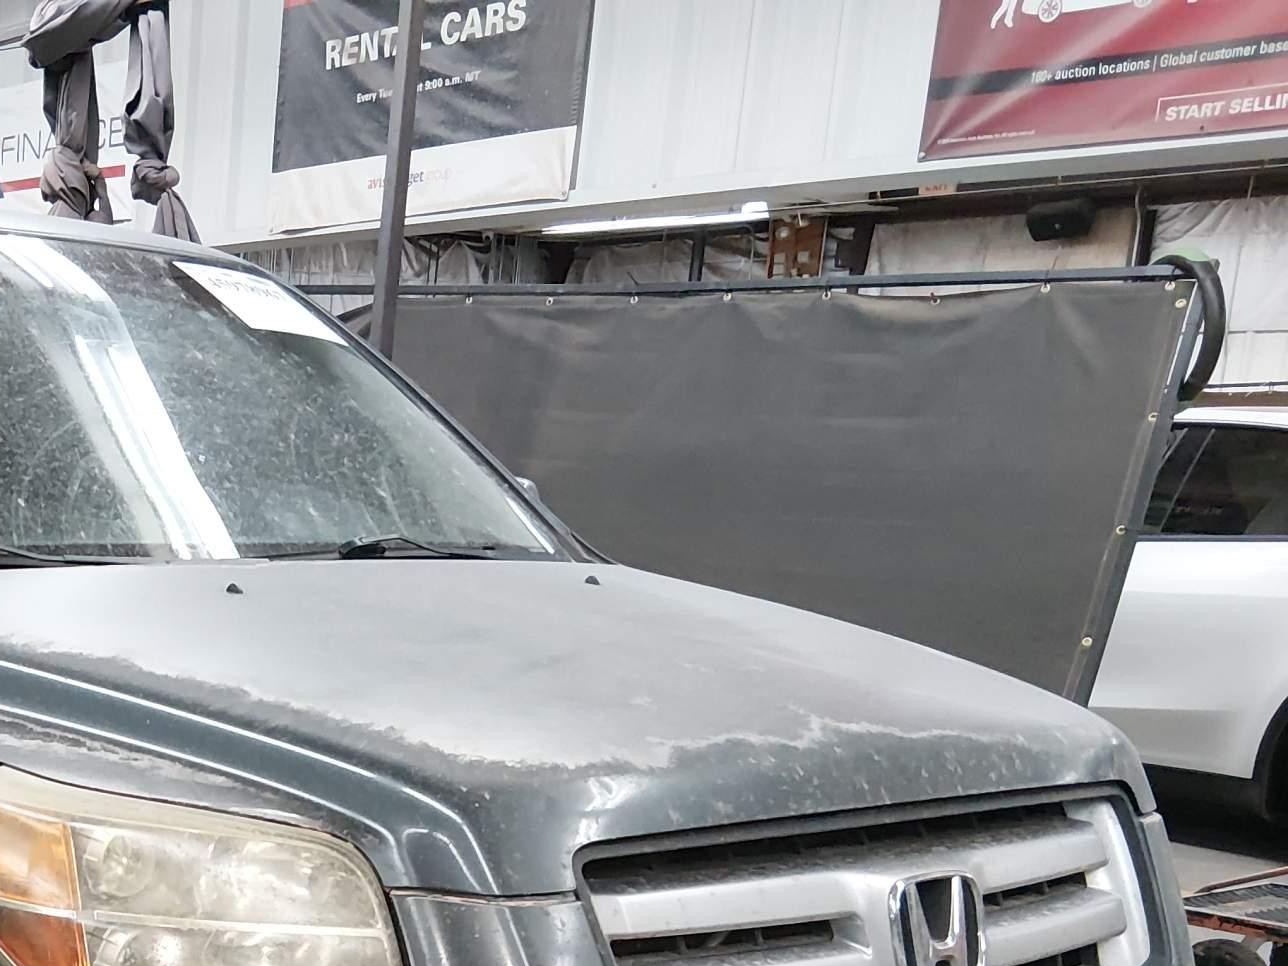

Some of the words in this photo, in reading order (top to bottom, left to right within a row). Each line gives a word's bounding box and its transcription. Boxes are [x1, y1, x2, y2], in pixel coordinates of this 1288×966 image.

[324, 26, 431, 71] RENTL
[440, 0, 527, 46] CARS
[1054, 67, 1096, 81] auction
[1098, 57, 1150, 76] locations
[1159, 49, 1198, 68] Global
[1199, 44, 1257, 63] customer
[356, 91, 377, 104] Every
[425, 77, 444, 91] 9:00
[1164, 100, 1226, 122] START
